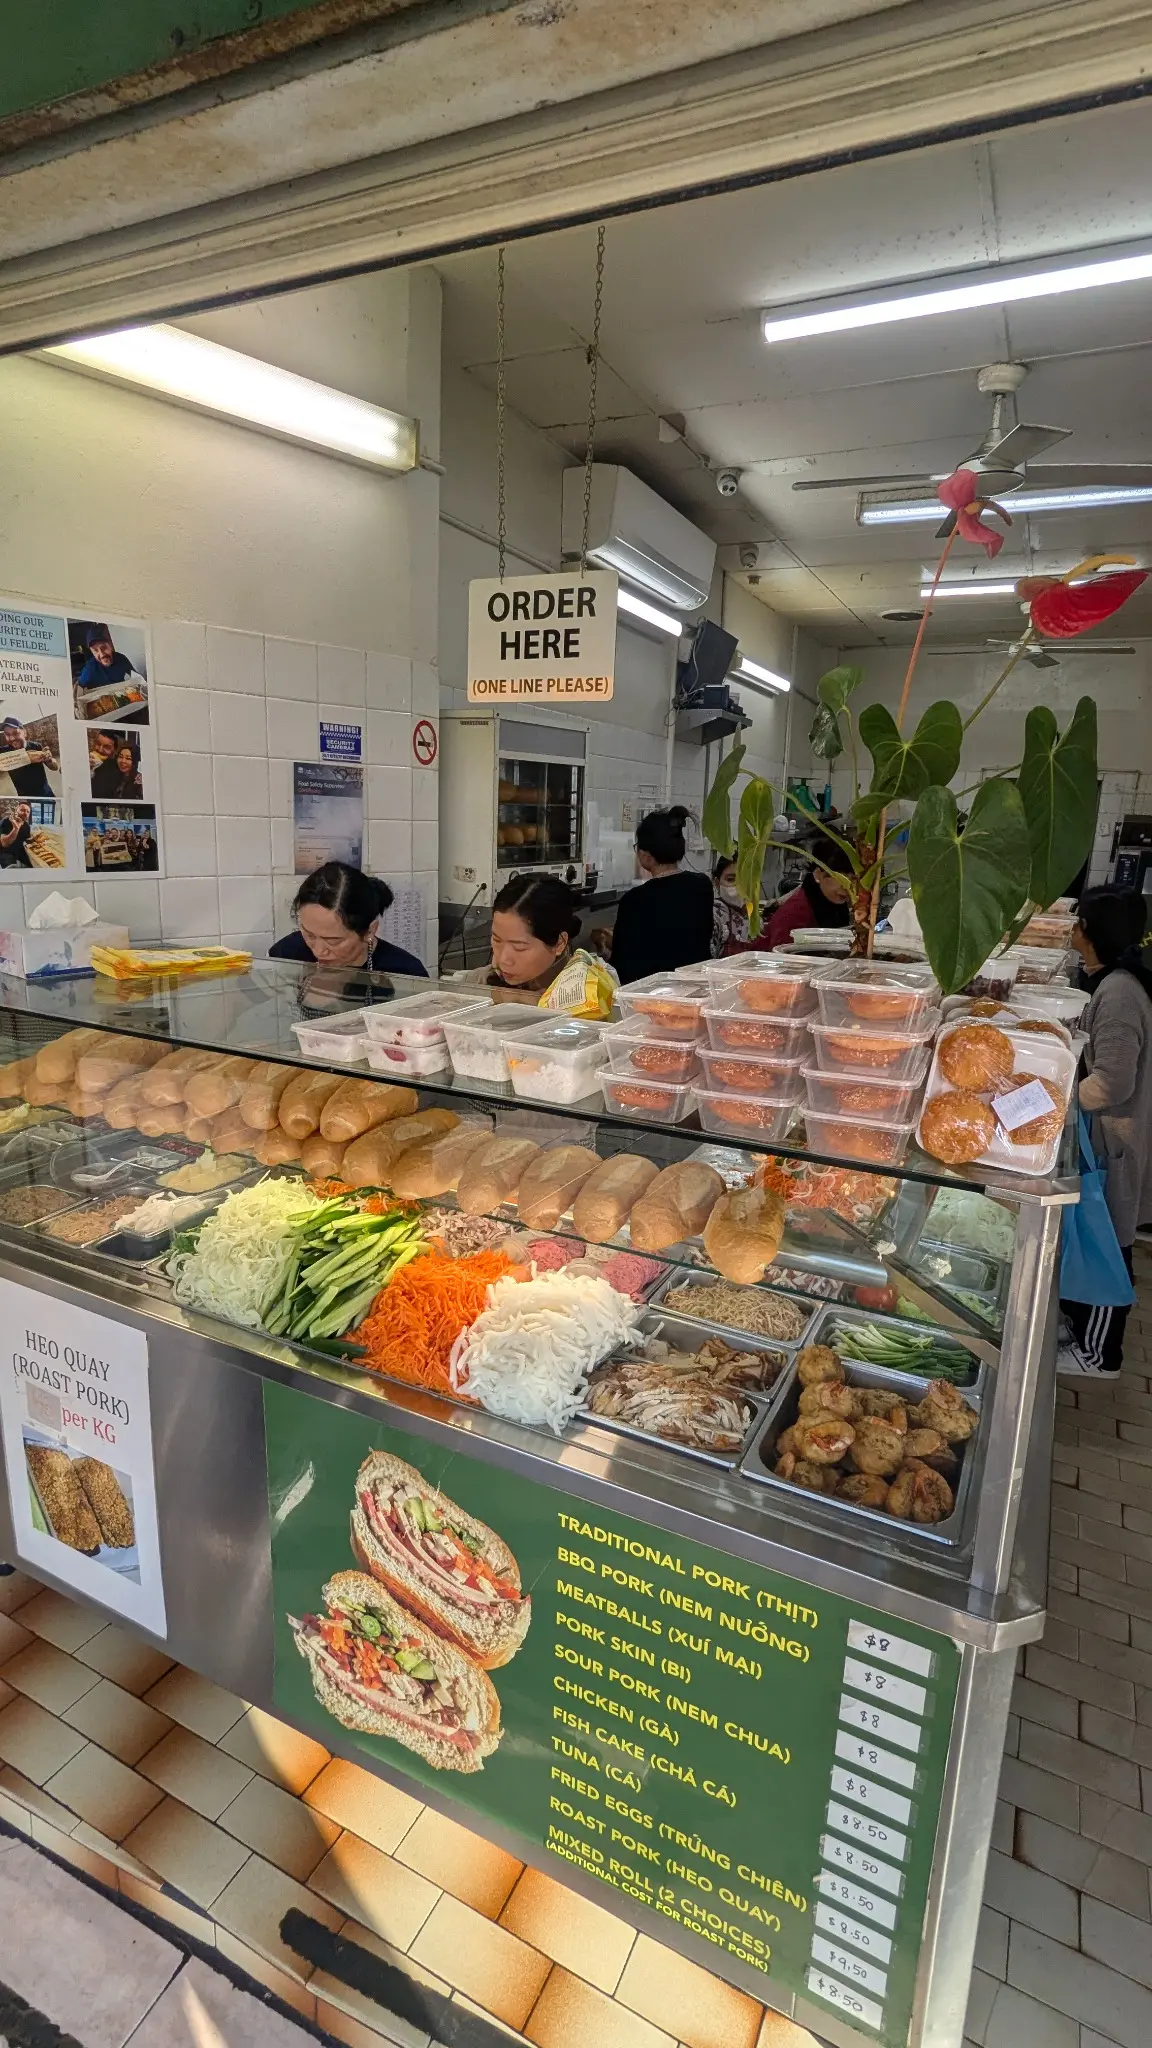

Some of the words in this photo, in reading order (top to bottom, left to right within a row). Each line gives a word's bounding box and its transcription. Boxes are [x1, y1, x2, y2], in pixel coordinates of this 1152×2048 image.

[24, 616, 44, 628] OUR
[487, 587, 597, 622] ORDER
[10, 638, 50, 652] FEILDEL
[28, 629, 54, 641] CHEF
[500, 628, 580, 660] HERE
[472, 679, 507, 696] (ONE
[510, 678, 543, 694] LINE
[546, 676, 609, 694] PLEASE)
[322, 723, 359, 734] WARNING!
[25, 1330, 58, 1360] HEO
[64, 1347, 110, 1382] QUAY
[13, 1353, 72, 1394] (ROAST
[76, 1380, 130, 1425] PORK)
[62, 1408, 88, 1430] per
[92, 1416, 116, 1444] KG
[558, 1512, 686, 1575] TRADITIONAL
[692, 1564, 750, 1600] PORK
[756, 1590, 818, 1628] (THỊT)
[558, 1546, 596, 1574] BBQ
[601, 1564, 654, 1598] PORK
[660, 1588, 712, 1622] (NEM
[556, 1580, 662, 1635] MEATBALLS
[668, 1626, 711, 1655] (XUÍ
[716, 1646, 762, 1680] MẠI)
[864, 1633, 890, 1652] $8
[556, 1612, 606, 1645] PORK
[610, 1636, 655, 1666] SKIN
[662, 1658, 691, 1684] (BI)
[865, 1672, 886, 1689] $8
[554, 1676, 634, 1723] CHICKEN
[640, 1716, 679, 1746] (GÀ)
[555, 1644, 603, 1676] SOUR
[609, 1668, 660, 1703] PORK
[666, 1695, 718, 1729] (NEM
[724, 1722, 790, 1764] CHUA)
[860, 1710, 880, 1728] $8
[552, 1736, 600, 1771] TUNA
[606, 1764, 641, 1793] (CÁ)
[553, 1706, 590, 1734] FISH
[596, 1728, 645, 1761] CAKE
[651, 1754, 697, 1787] (CHẢ
[703, 1780, 736, 1808] CÁ)
[858, 1746, 878, 1764] $8
[846, 1778, 867, 1798] $8
[551, 1766, 600, 1800] FRIED
[606, 1794, 653, 1829] EGGS
[737, 1865, 806, 1912] CHIÊN)
[842, 1814, 888, 1841] $8.50
[550, 1796, 606, 1834] ROAST
[612, 1828, 660, 1865] PORK
[666, 1859, 713, 1892] (HEO
[719, 1888, 780, 1932] QUAY)
[834, 1847, 878, 1874] $8.50
[546, 1840, 619, 1886] (ADDITIONAL
[622, 1883, 653, 1904] COST
[656, 1901, 680, 1922] FOR
[684, 1917, 725, 1946] ROAST
[728, 1942, 768, 1972] PORK)
[550, 1825, 604, 1863] MIXED
[610, 1858, 654, 1892] ROLL
[659, 1886, 675, 1904] (2
[680, 1899, 770, 1960] CHOICES)
[830, 1881, 874, 1911] $8.50
[828, 1917, 870, 1945] $8.50
[817, 1977, 863, 2012] $8.50
